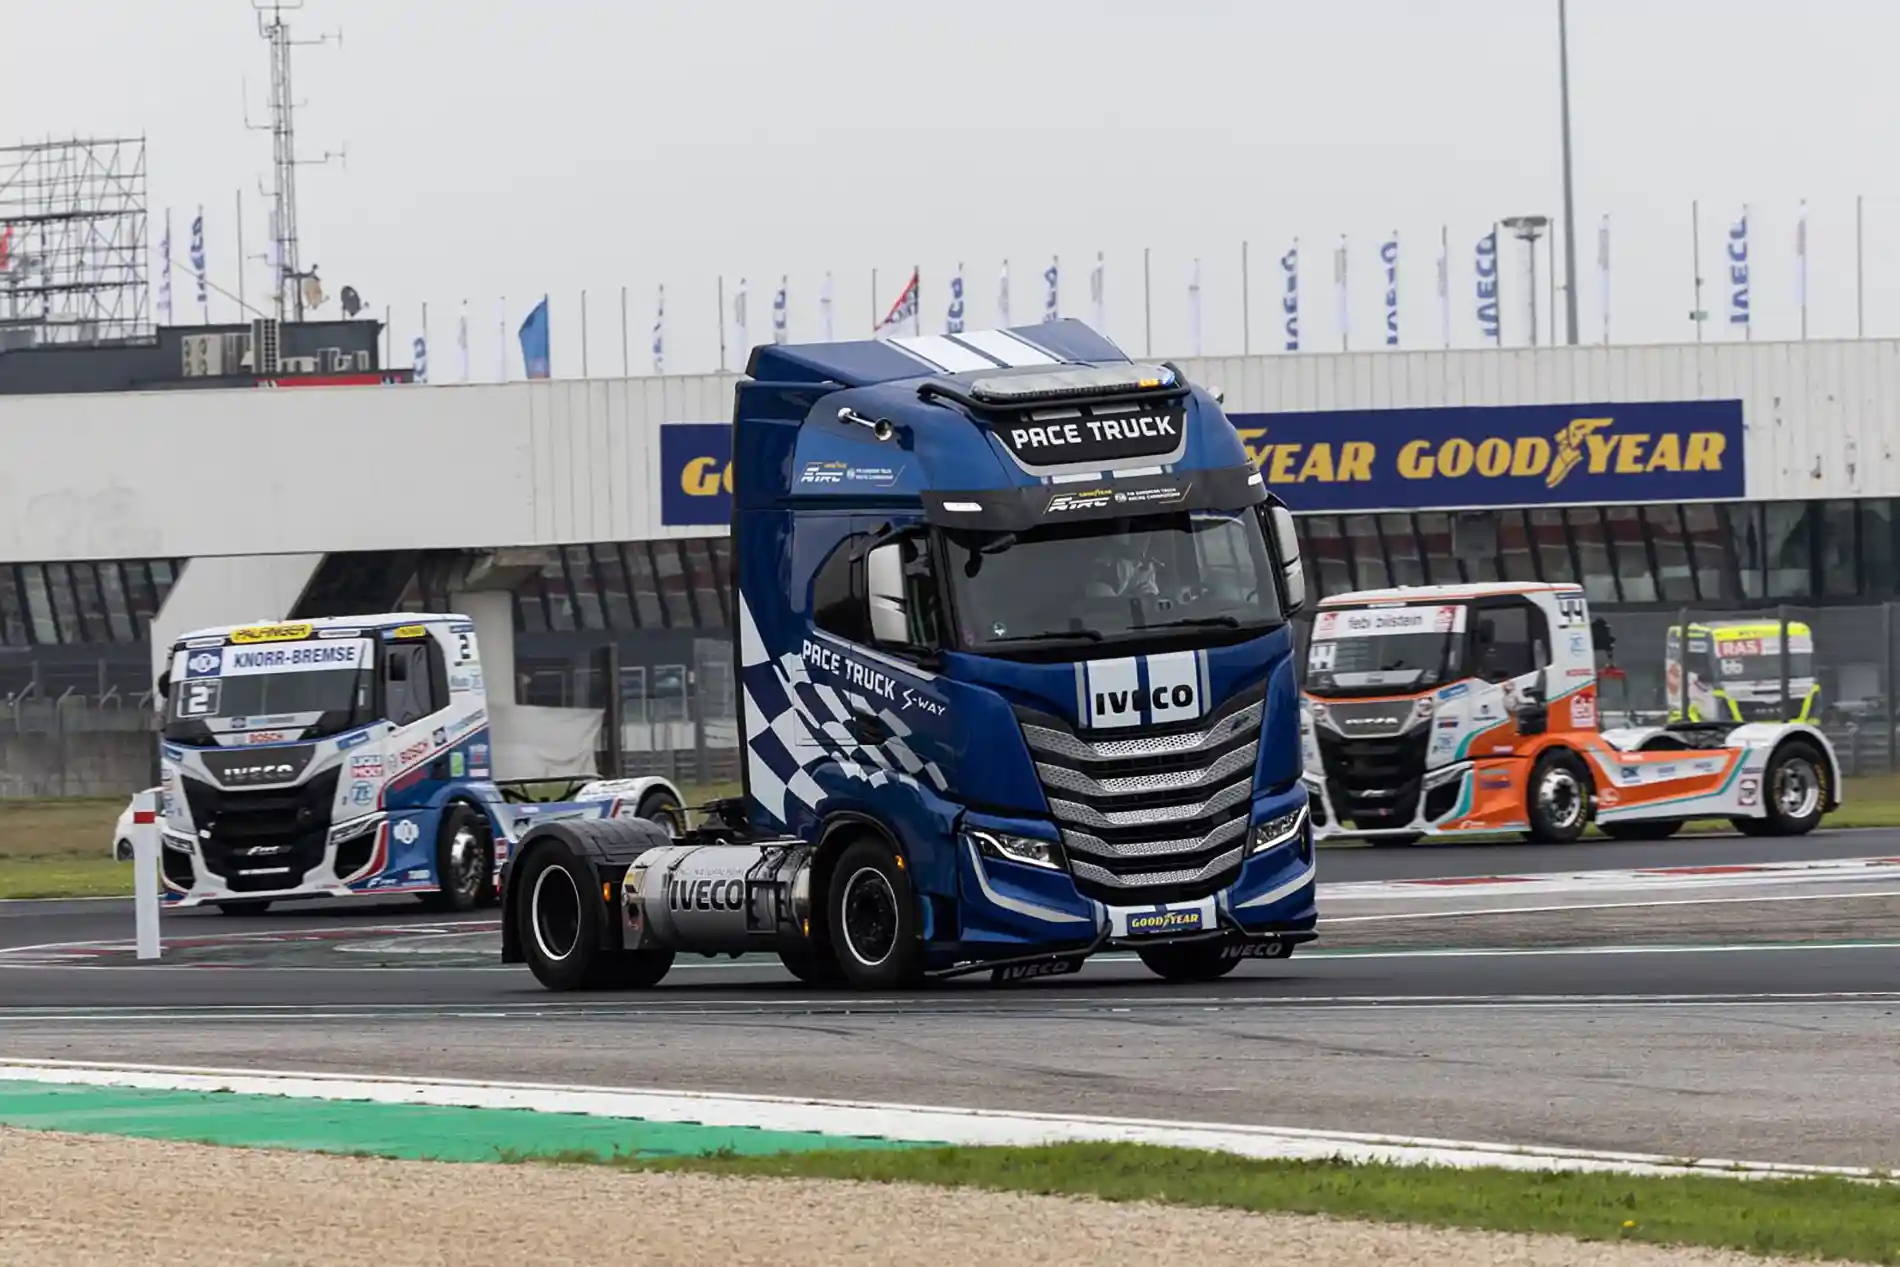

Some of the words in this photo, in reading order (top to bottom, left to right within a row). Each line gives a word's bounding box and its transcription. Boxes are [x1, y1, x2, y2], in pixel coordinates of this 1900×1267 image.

[1476, 232, 1499, 337] IVECO
[1011, 424, 1082, 449] PACE
[1086, 415, 1176, 441] TRUCK
[681, 456, 733, 496] G
[1559, 599, 1585, 623] 44
[234, 647, 356, 668] KNORR-BREMSE
[459, 634, 471, 659] 2
[1723, 640, 1757, 655] RAS
[803, 639, 841, 675] PACE
[845, 659, 897, 701] TRUCK
[902, 688, 946, 716] S-WAY
[189, 685, 211, 713] 2
[223, 764, 294, 781] IVECO
[669, 879, 745, 912] IVECO
[1131, 913, 1199, 929] GOODYEAR
[1220, 943, 1282, 959] IVECO
[1003, 962, 1070, 980] IVECO
